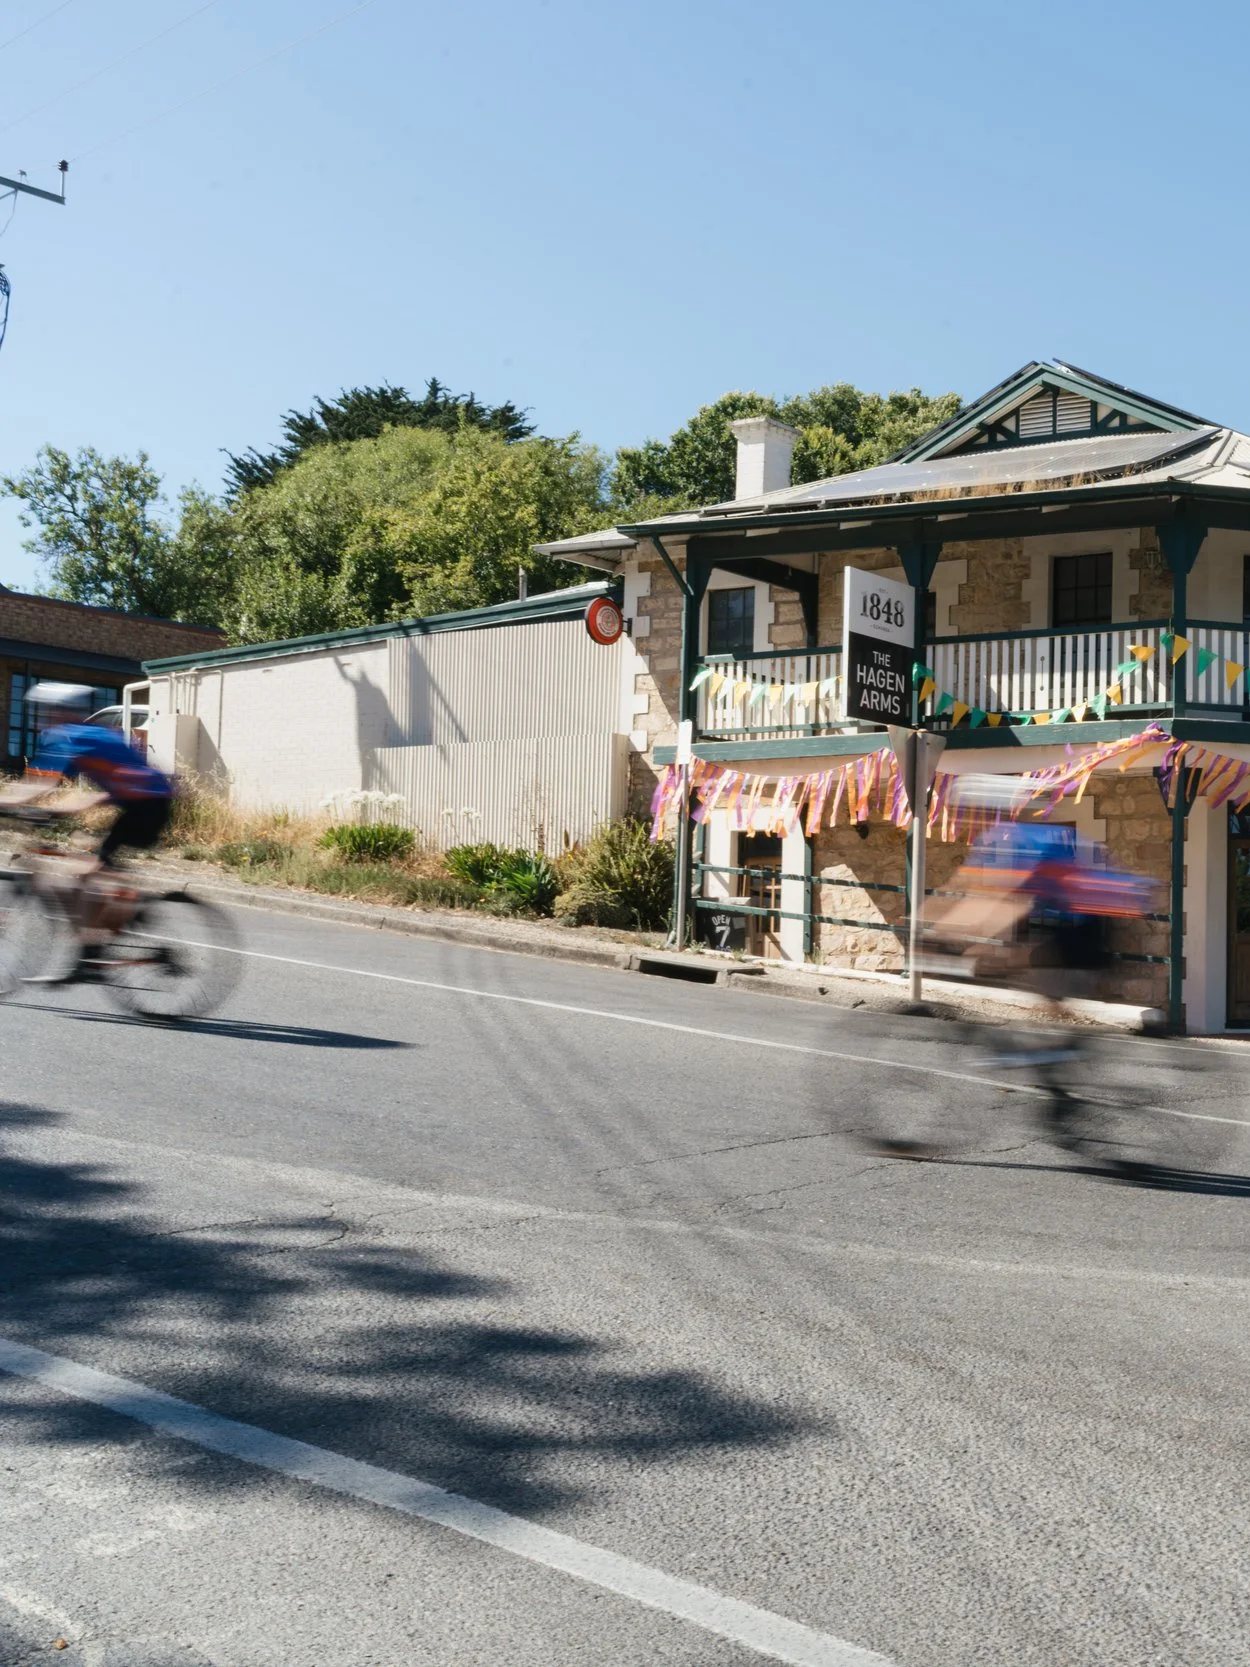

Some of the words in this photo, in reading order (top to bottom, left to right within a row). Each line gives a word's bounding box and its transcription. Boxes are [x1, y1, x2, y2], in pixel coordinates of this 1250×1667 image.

[860, 590, 905, 628] 1848
[872, 650, 891, 667] THE
[856, 663, 905, 694] HAGEN
[860, 688, 901, 715] ARMS
[711, 914, 731, 926] OPEN
[715, 925, 731, 948] 7
